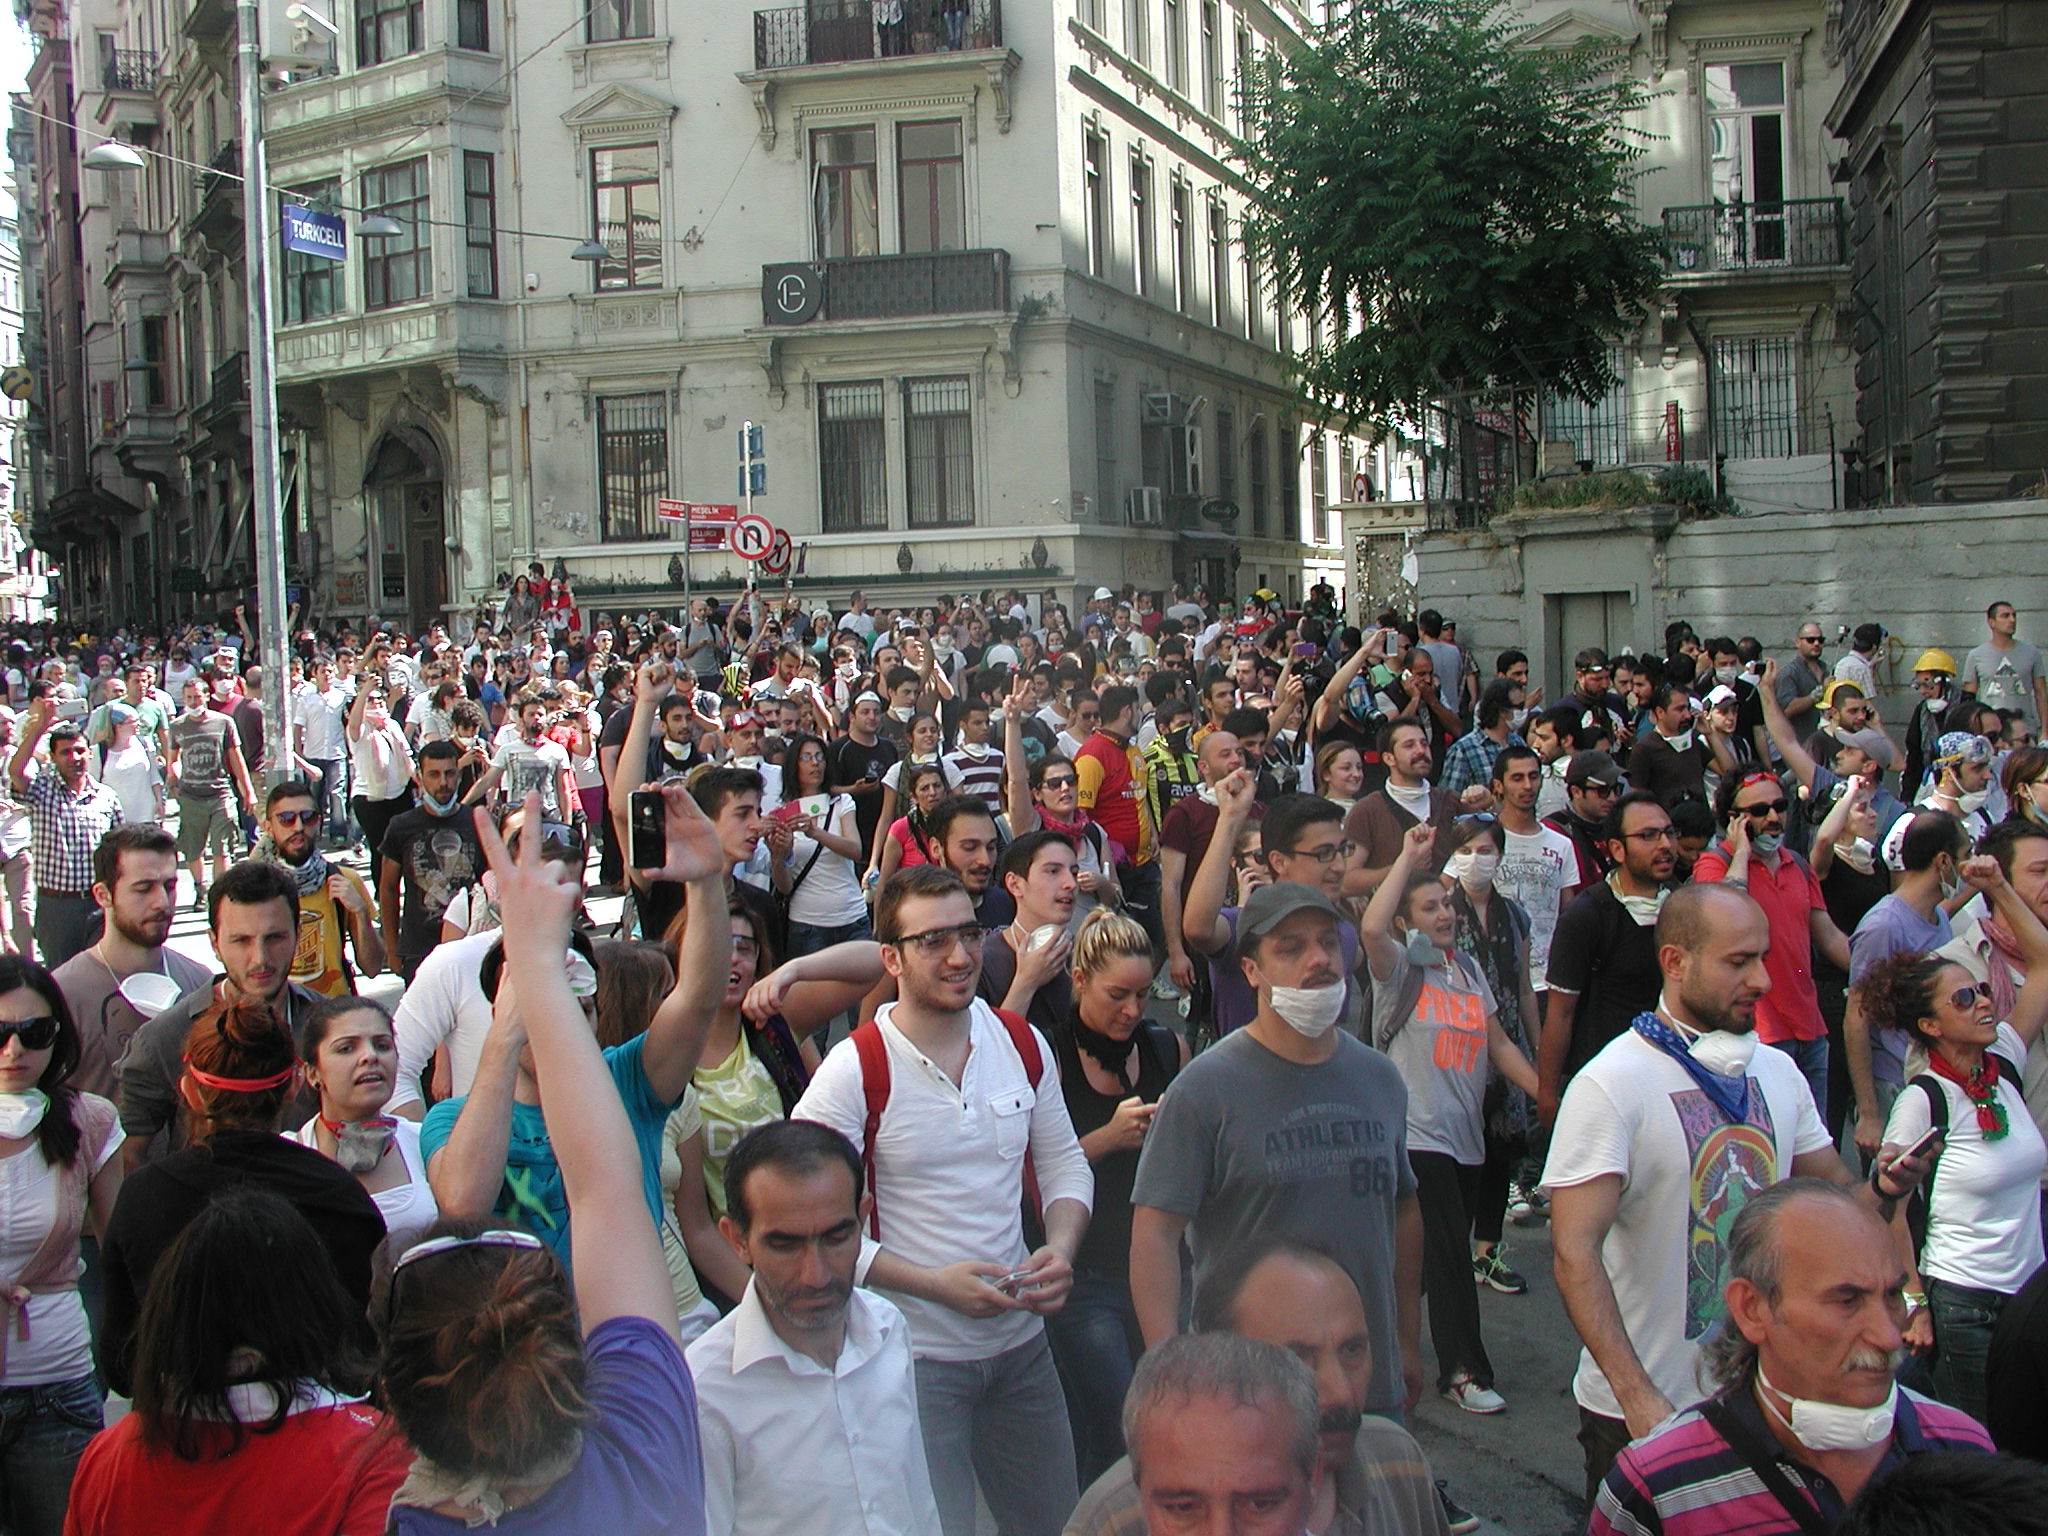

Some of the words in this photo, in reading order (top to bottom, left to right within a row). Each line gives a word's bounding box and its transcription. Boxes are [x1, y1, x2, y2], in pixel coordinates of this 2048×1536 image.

[291, 219, 345, 248] TURKCELL
[1415, 984, 1488, 1033] FREA
[1433, 1028, 1486, 1073] OUT
[1264, 1120, 1385, 1157] ATHLETIC
[1349, 1157, 1390, 1196] 86
